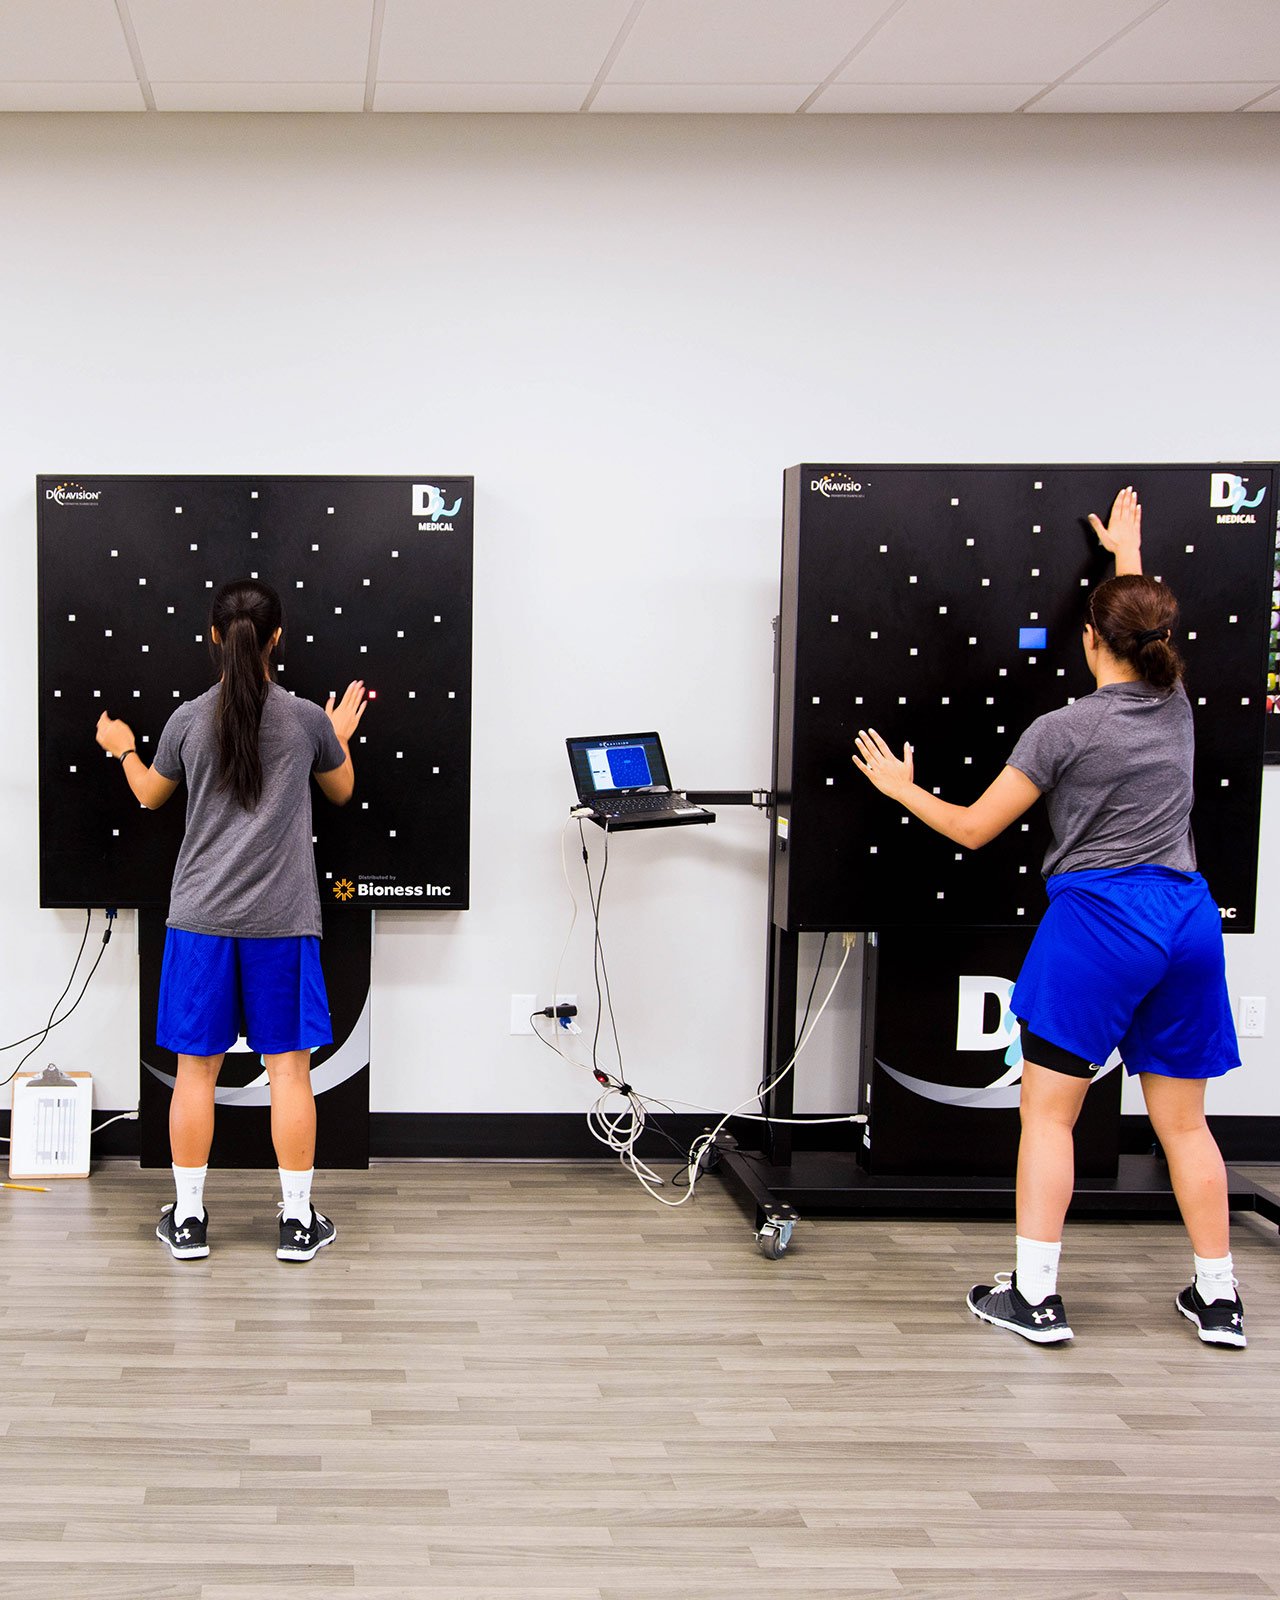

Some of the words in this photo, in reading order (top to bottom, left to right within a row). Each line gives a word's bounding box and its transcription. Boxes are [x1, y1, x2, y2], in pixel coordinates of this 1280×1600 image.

[1216, 514, 1257, 524] MEDICAL
[418, 522, 454, 531] MEDICAL
[357, 882, 424, 896] Bioness
[426, 883, 451, 896] Inc
[1217, 907, 1237, 919] nc
